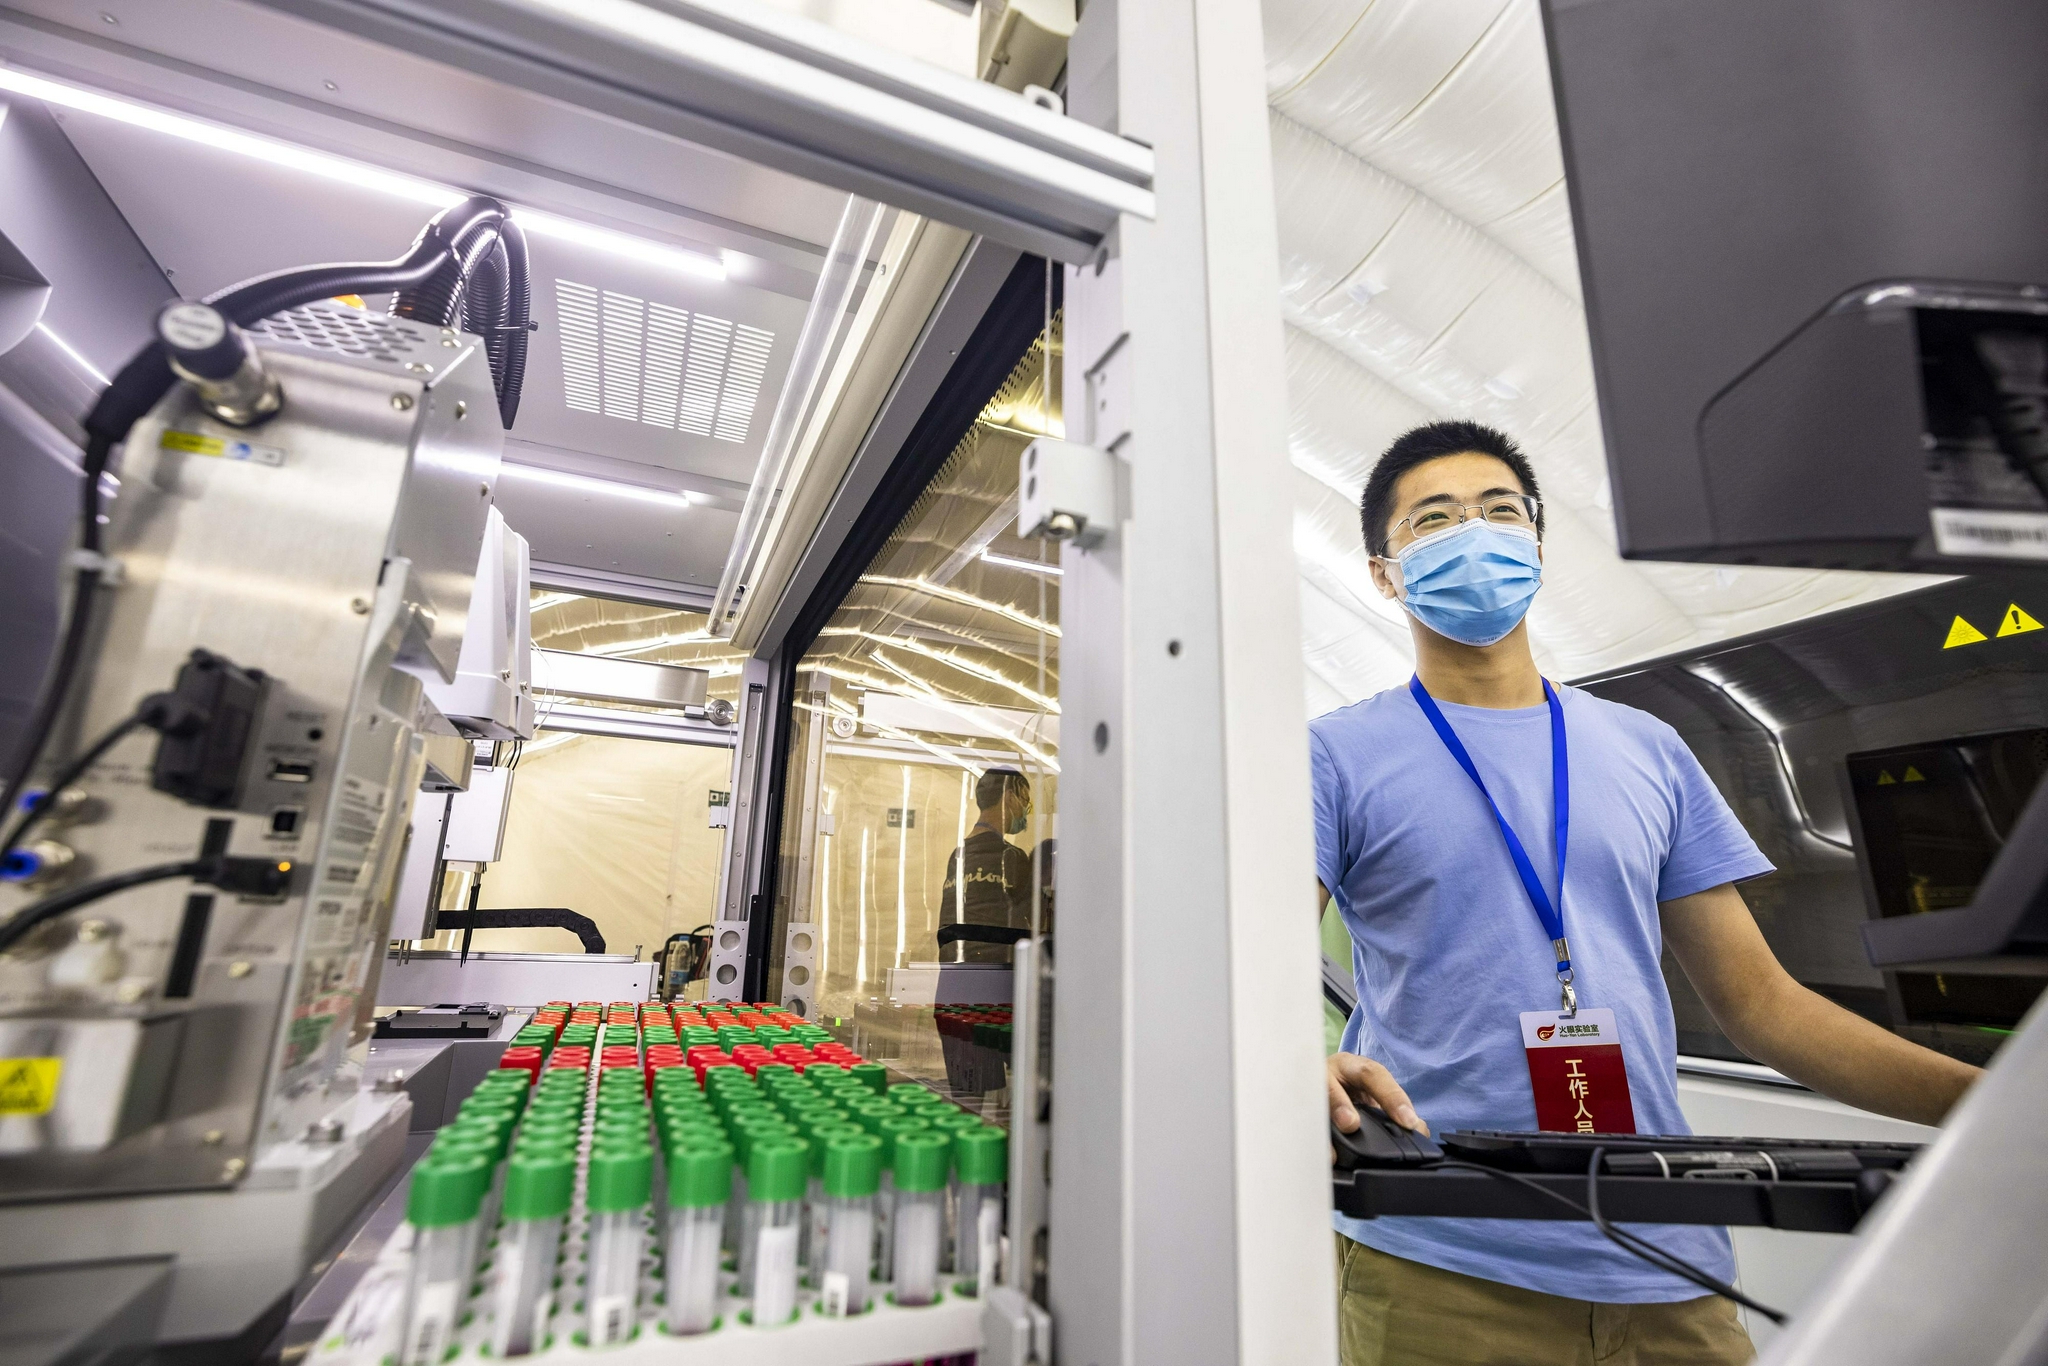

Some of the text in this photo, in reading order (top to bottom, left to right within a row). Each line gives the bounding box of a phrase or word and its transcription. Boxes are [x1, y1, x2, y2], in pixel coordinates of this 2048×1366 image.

[1559, 1024, 1599, 1033] 火眼实验室
